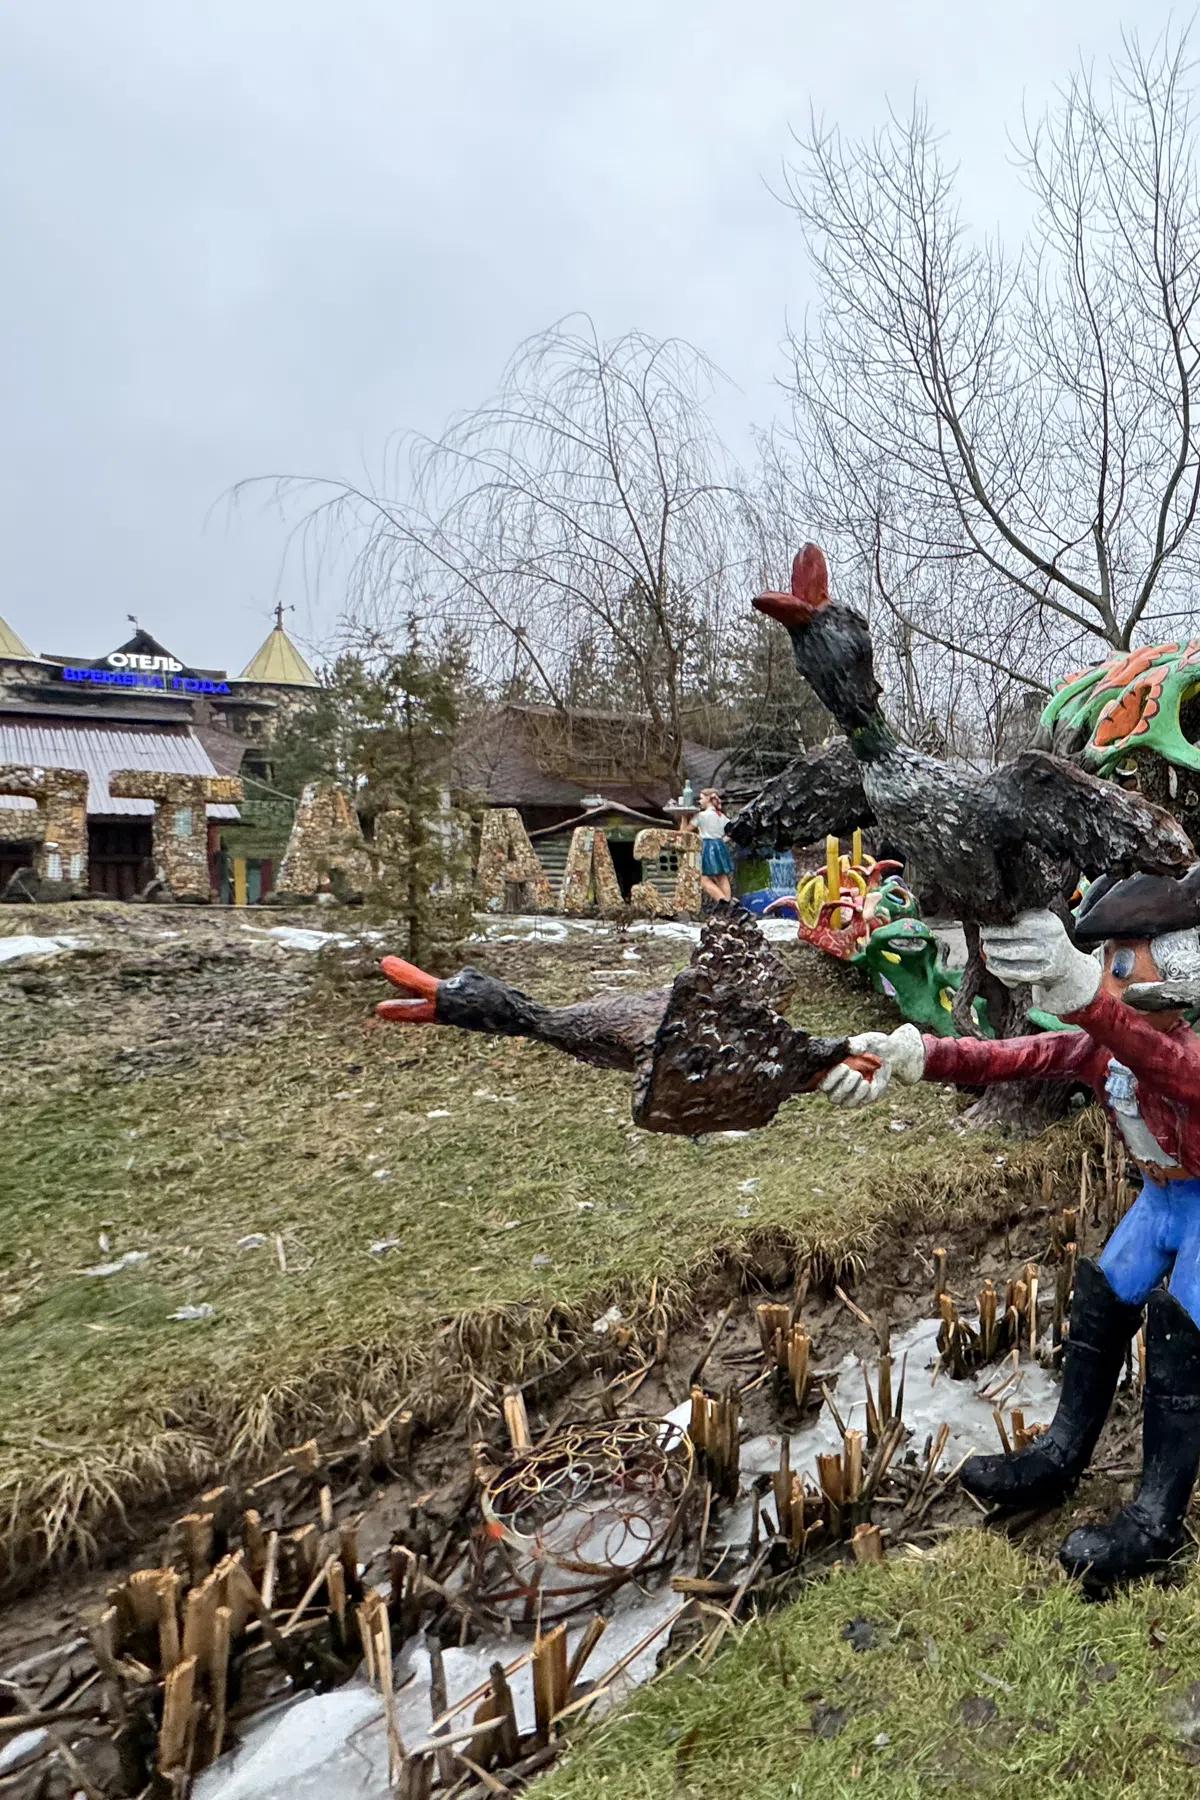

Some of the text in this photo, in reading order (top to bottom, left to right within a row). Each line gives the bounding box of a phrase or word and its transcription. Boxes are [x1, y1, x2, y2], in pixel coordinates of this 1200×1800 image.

[107, 653, 183, 672] ОТЕЛЬ
[62, 667, 231, 694] ВРЕМЕНА ГОДА
